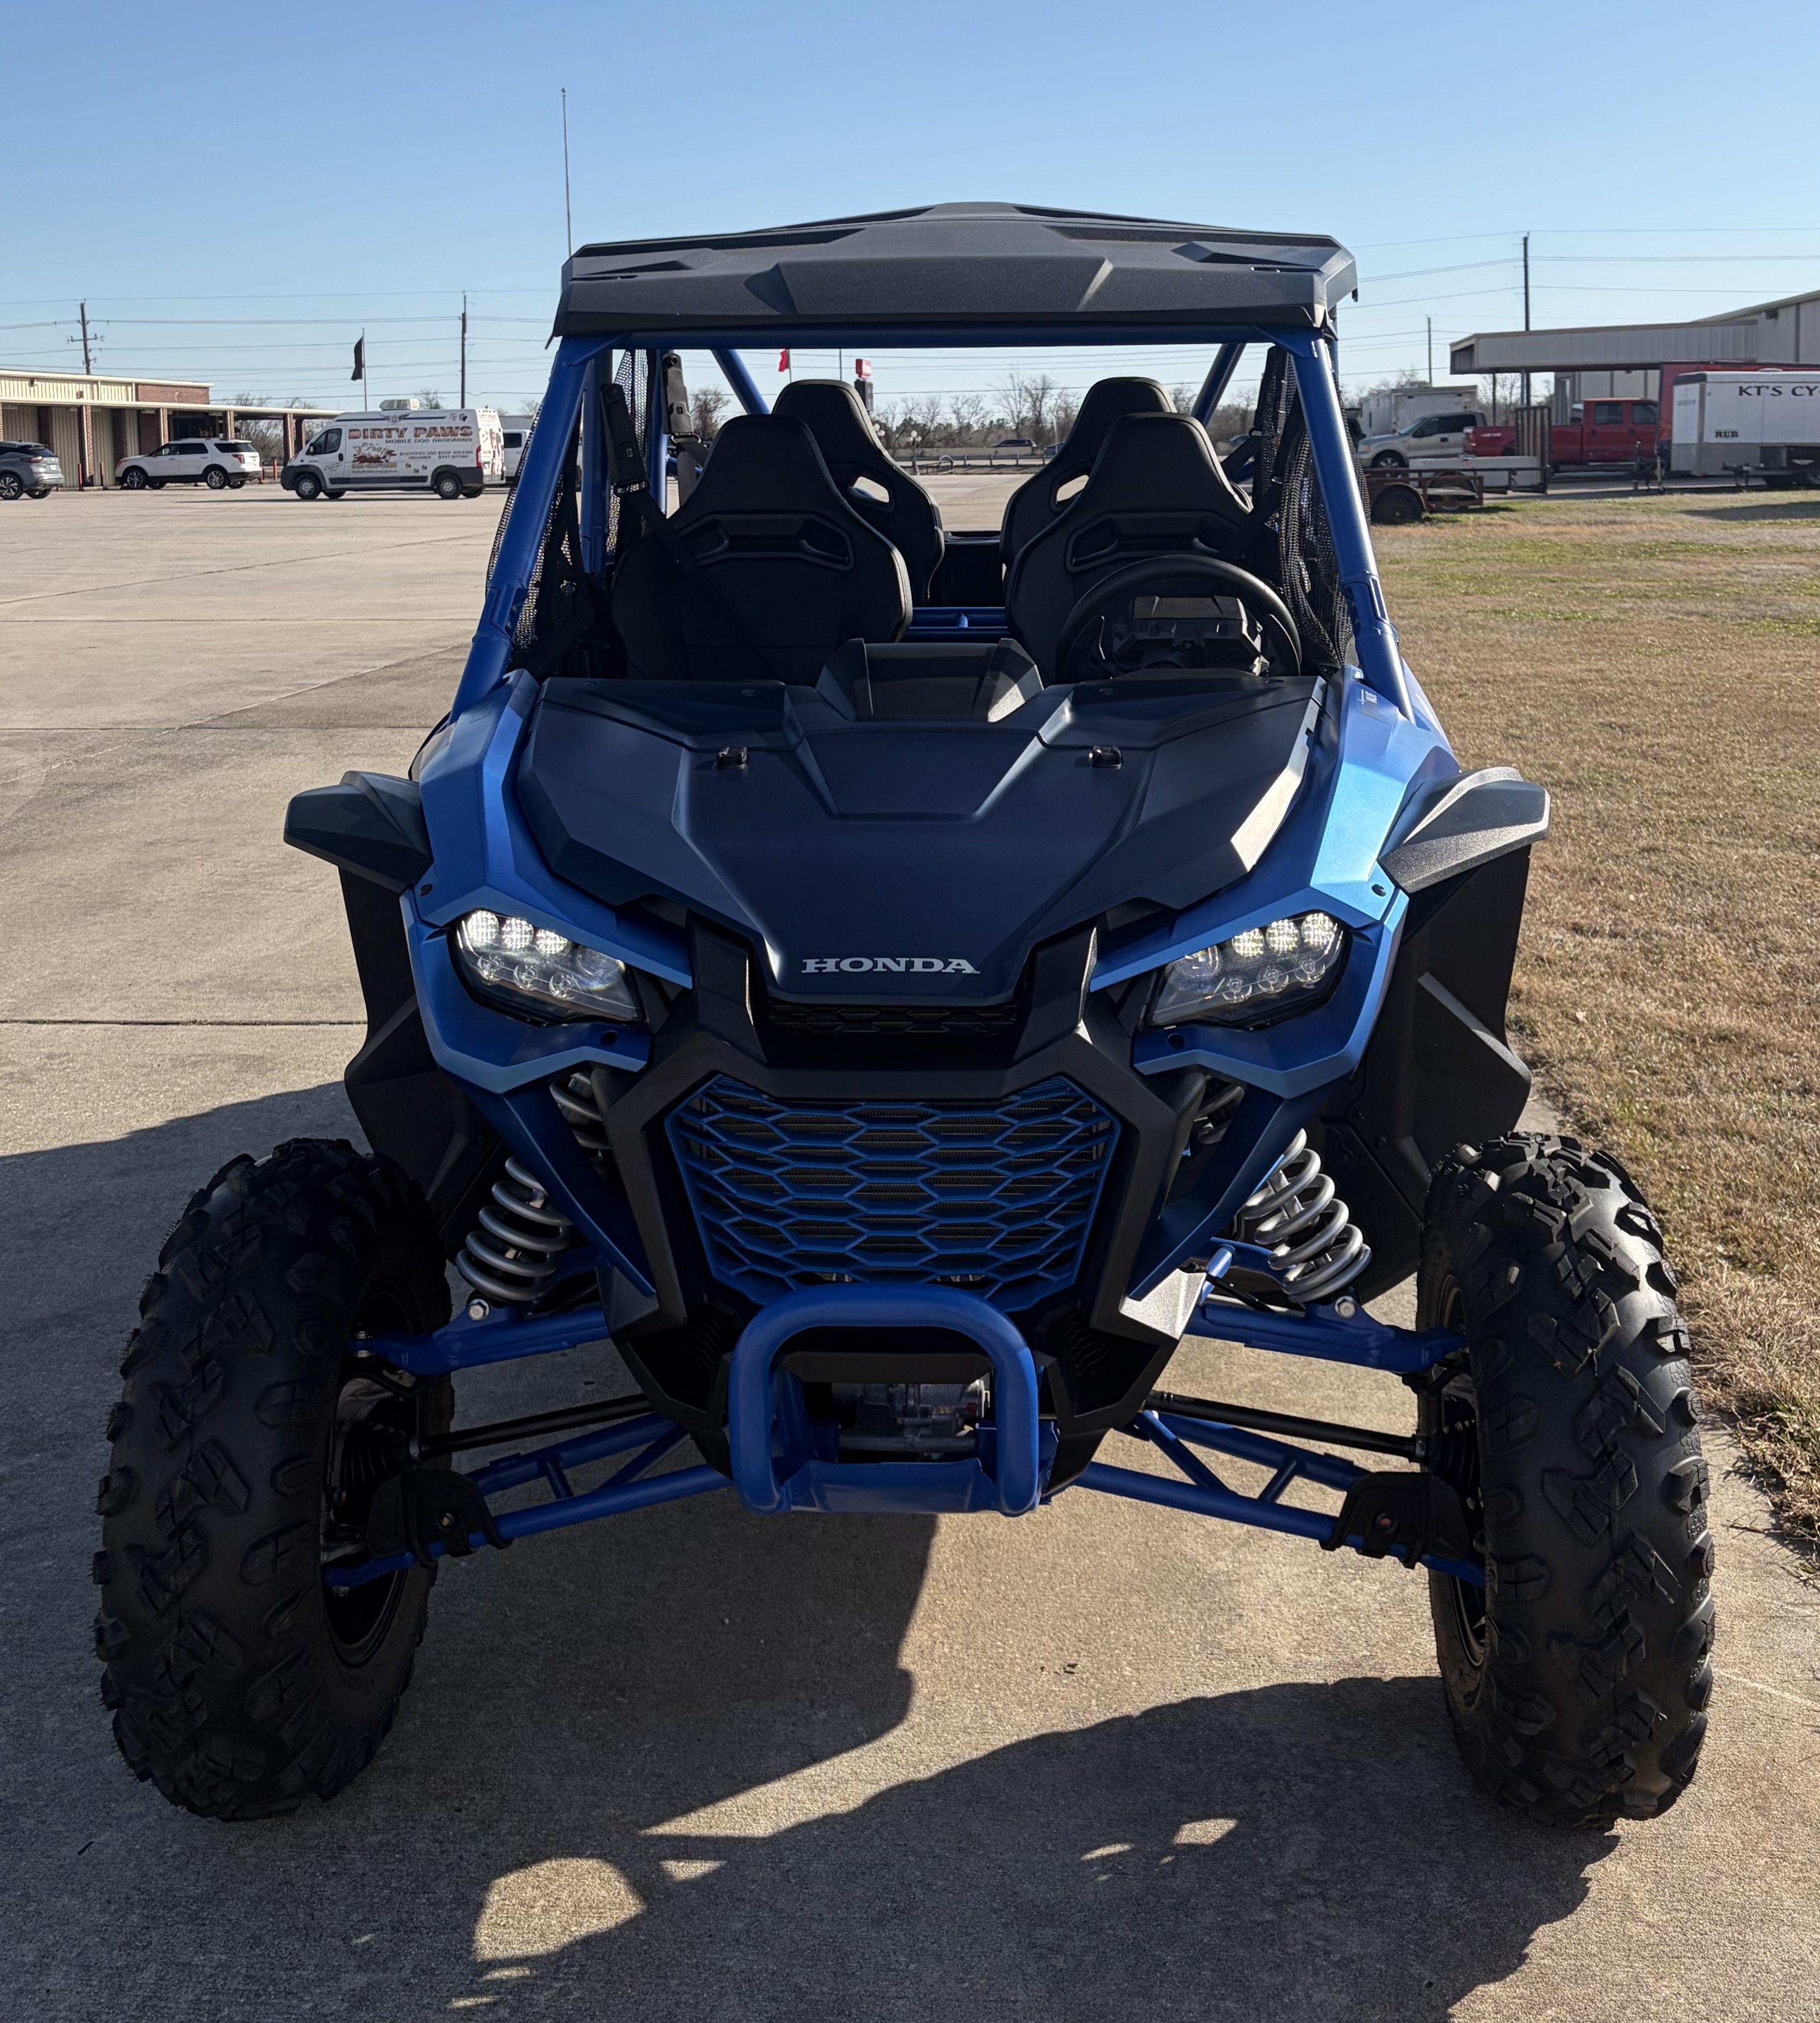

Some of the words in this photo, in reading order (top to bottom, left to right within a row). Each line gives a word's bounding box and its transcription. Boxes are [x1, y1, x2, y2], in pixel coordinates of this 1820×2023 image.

[1738, 386, 1782, 397] KT'S
[1791, 386, 1820, 397] CY
[348, 428, 408, 439] DIRTY
[413, 426, 473, 437] PAWS
[802, 957, 980, 974] HONDA
